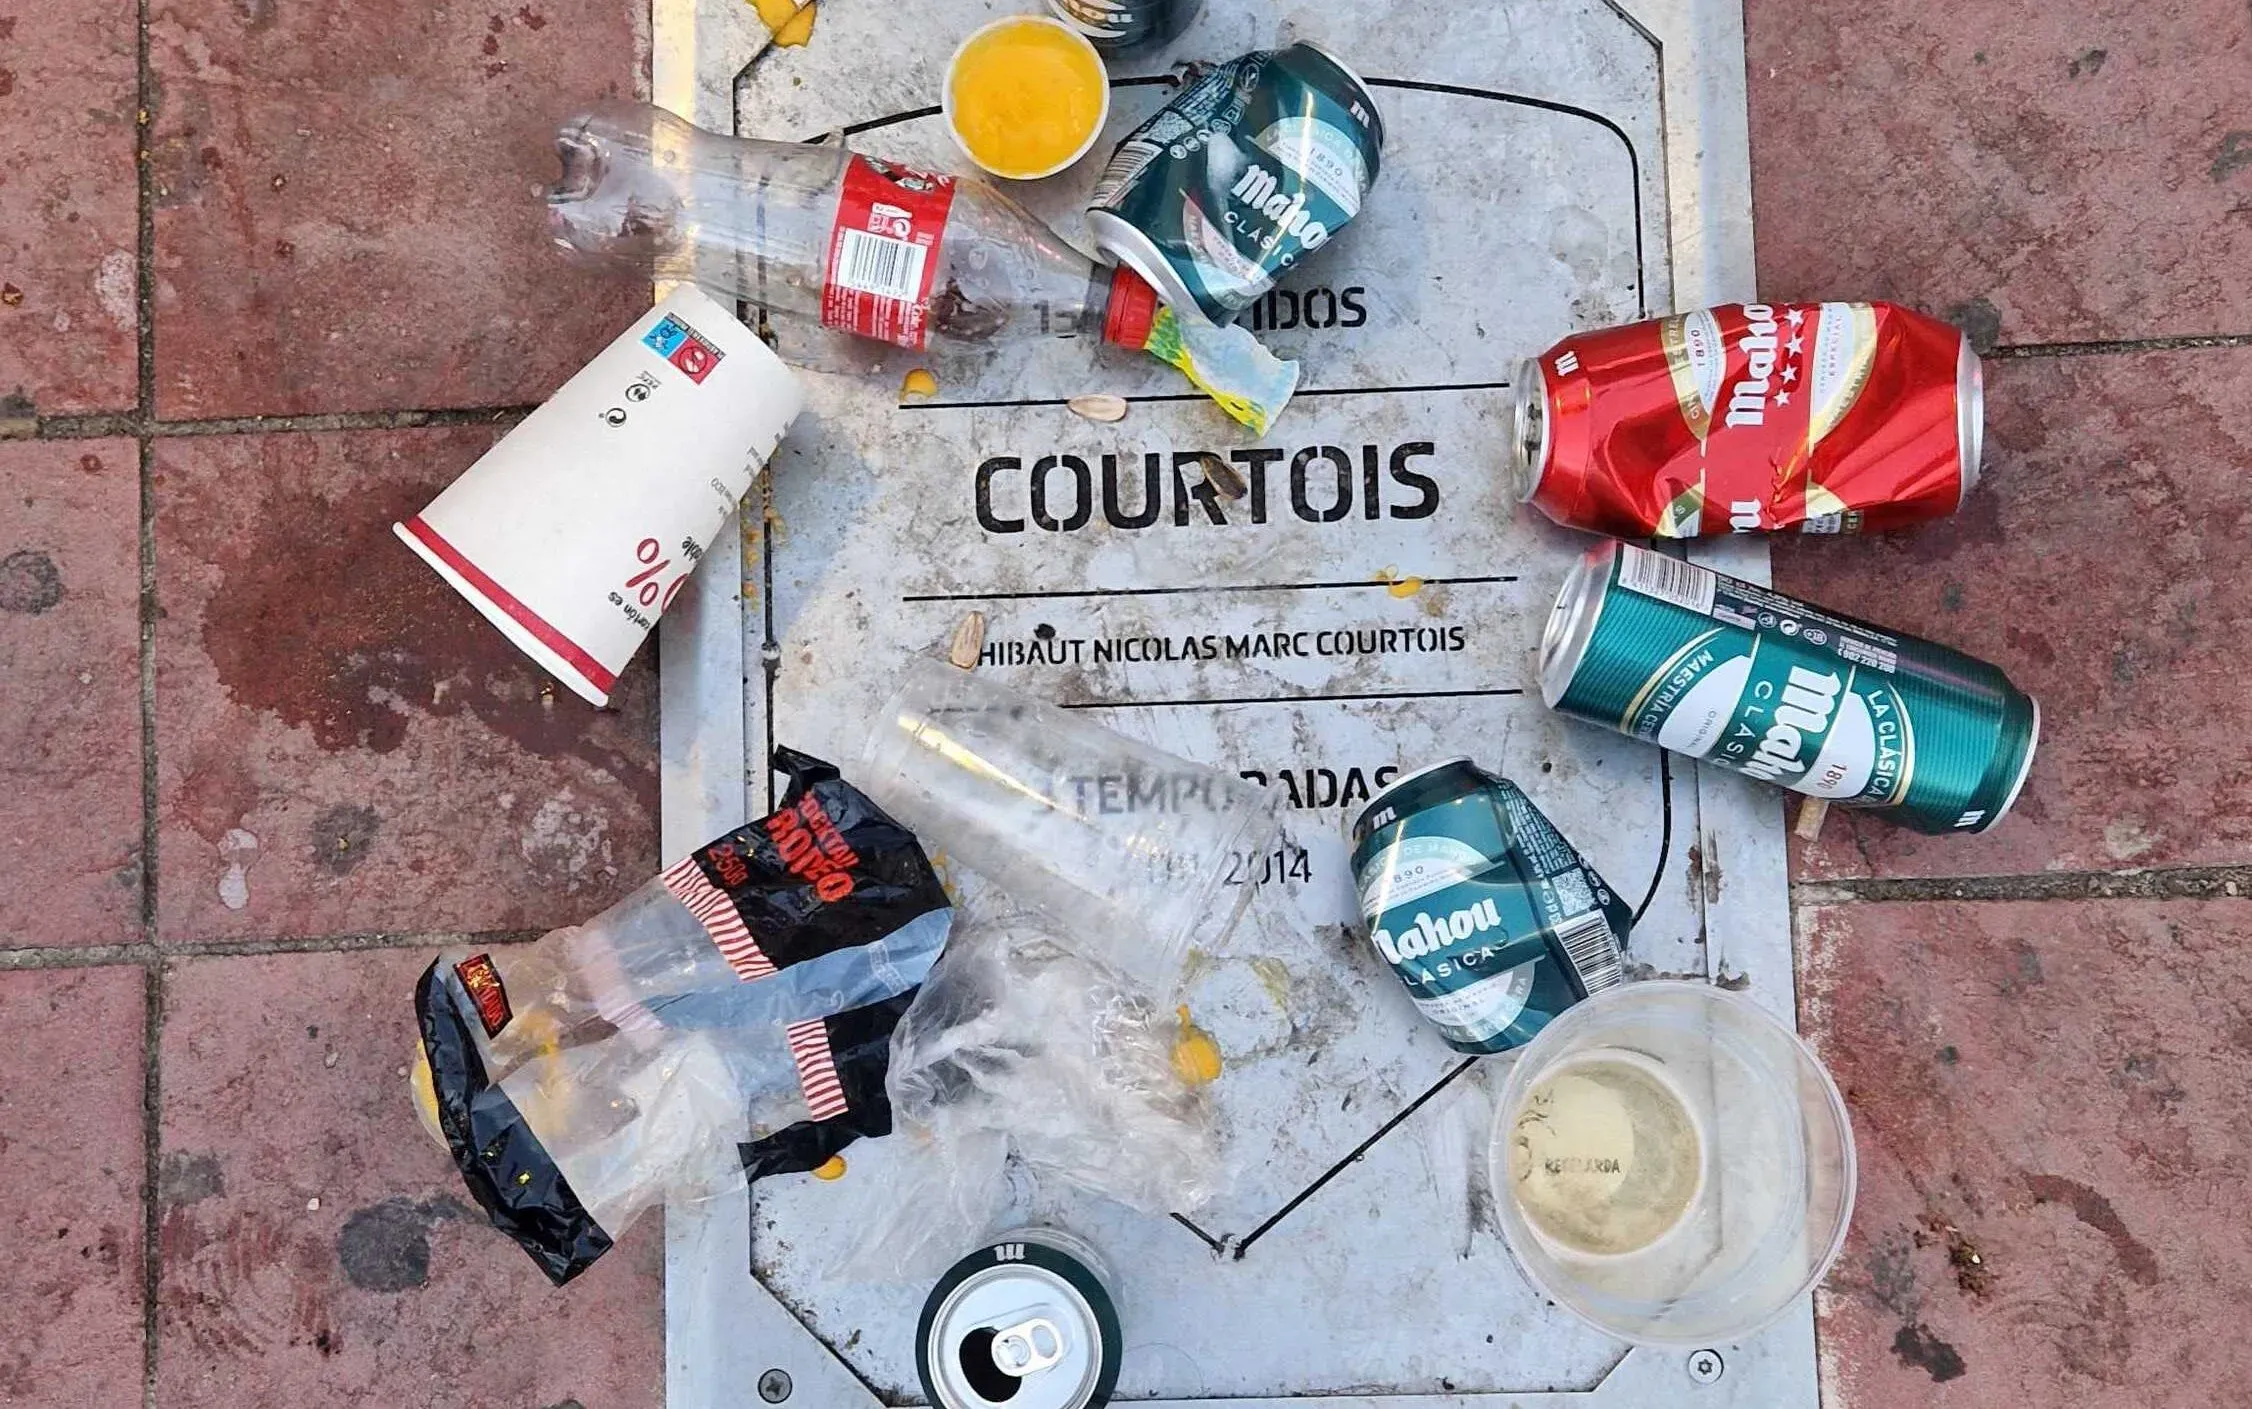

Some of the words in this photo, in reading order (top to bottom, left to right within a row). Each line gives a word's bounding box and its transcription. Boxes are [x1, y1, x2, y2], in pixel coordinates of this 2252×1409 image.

[1231, 164, 1329, 250] Maho
[1223, 211, 1300, 268] CLÁSIC
[1248, 287, 1367, 331] IDOS
[1724, 304, 1778, 429] Maho
[975, 442, 1440, 534] COURTOIS
[978, 640, 1085, 666] HIBAUT
[1094, 634, 1217, 663] NICOLAS
[1226, 631, 1309, 658] MARC
[1316, 626, 1465, 655] COURTOIS
[1867, 689, 1886, 719] LA
